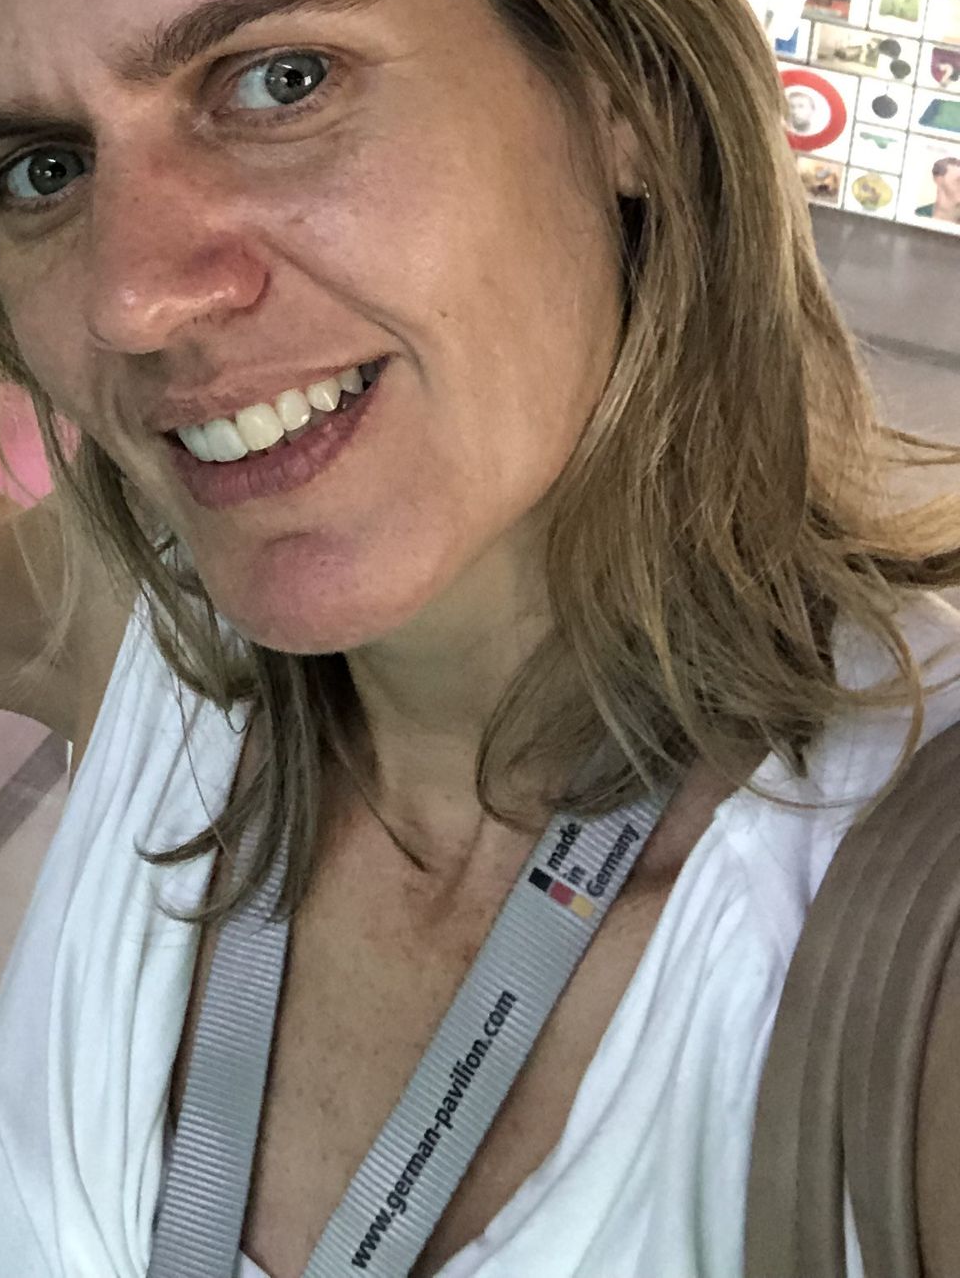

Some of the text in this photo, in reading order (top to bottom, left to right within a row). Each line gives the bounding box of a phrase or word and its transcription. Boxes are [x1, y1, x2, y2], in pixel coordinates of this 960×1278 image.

[547, 823, 581, 871] made
[562, 866, 586, 885] in
[586, 823, 640, 897] Germany
[351, 989, 518, 1270] www.german-pavilion.com
